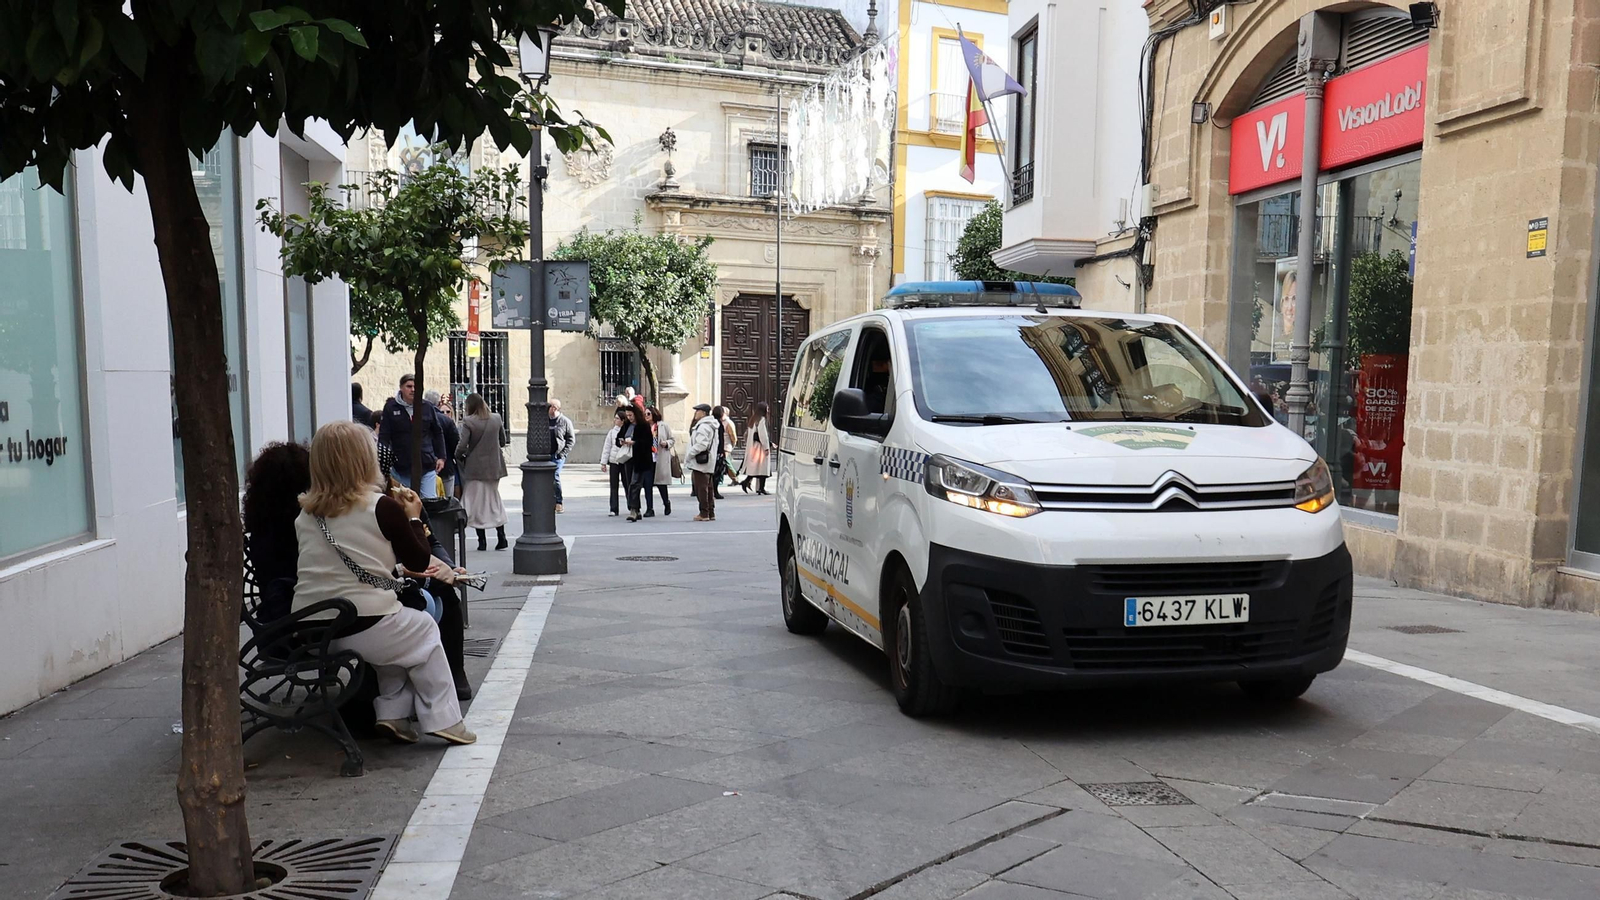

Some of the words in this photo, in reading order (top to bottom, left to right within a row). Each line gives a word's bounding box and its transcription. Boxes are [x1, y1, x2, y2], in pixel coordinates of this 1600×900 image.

[8, 437, 22, 463] tu
[26, 429, 68, 466] hogar
[823, 546, 850, 585] LOCAL
[1142, 600, 1196, 622] 6437
[1205, 597, 1243, 620] KLW
